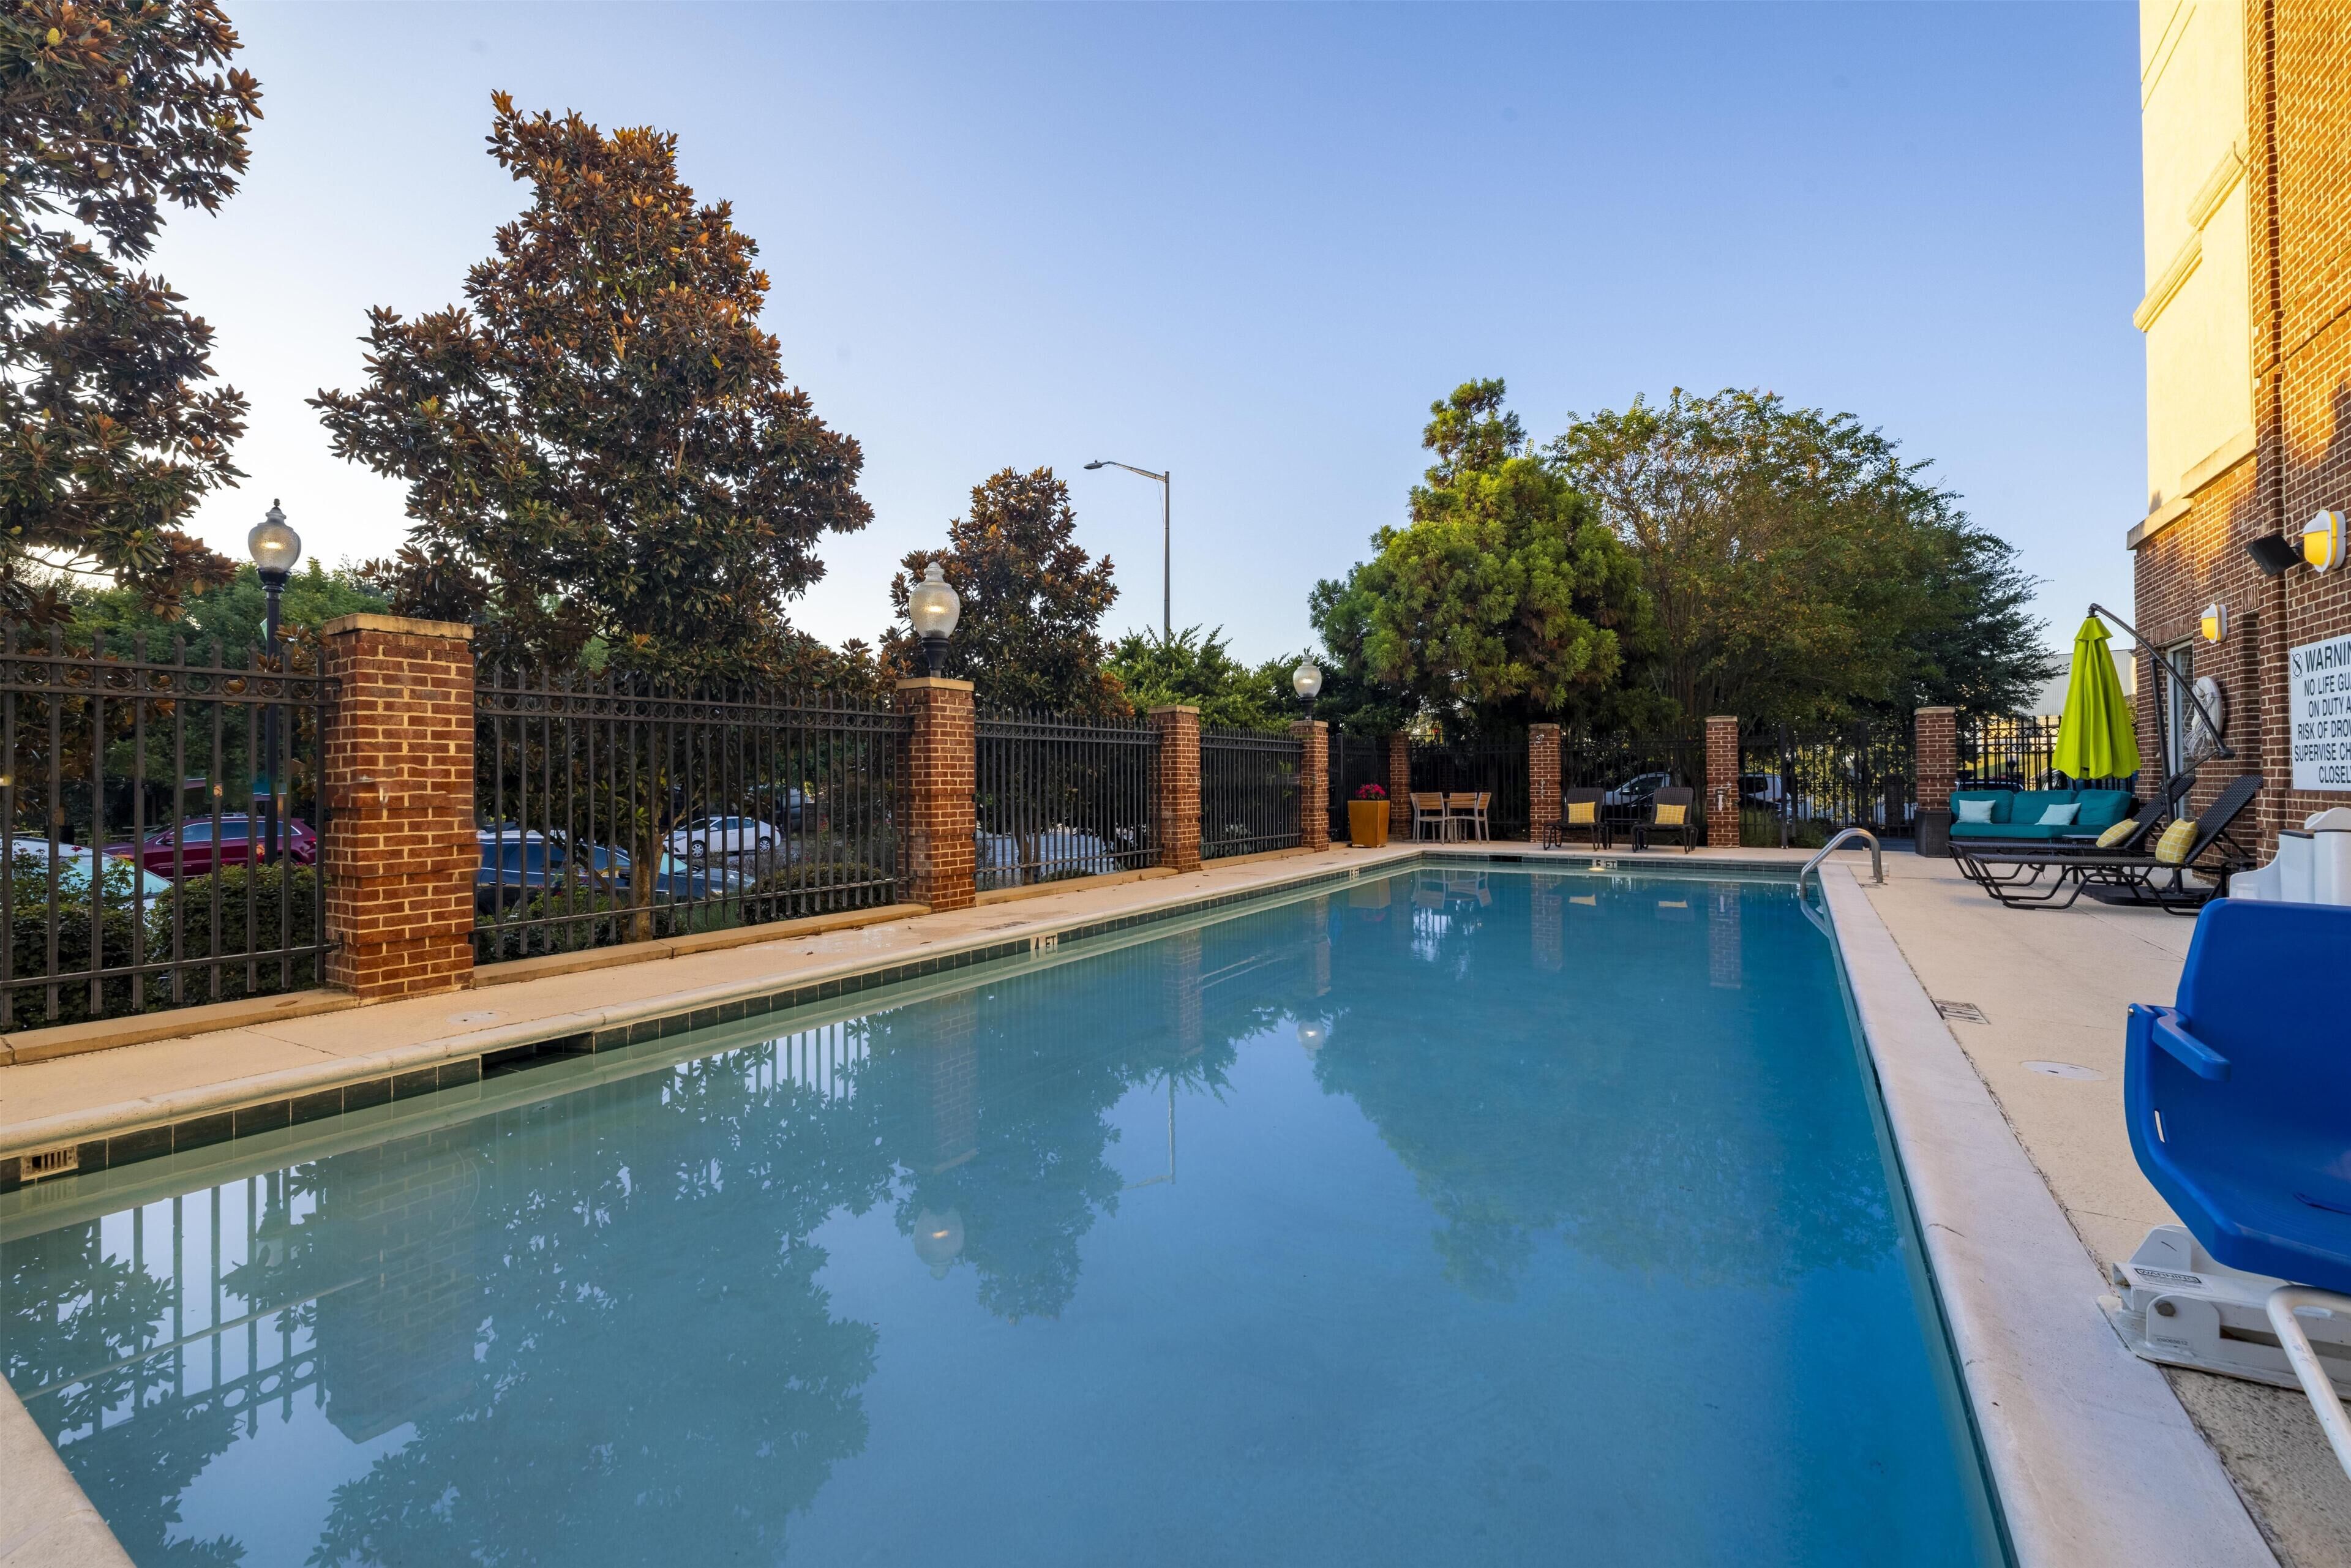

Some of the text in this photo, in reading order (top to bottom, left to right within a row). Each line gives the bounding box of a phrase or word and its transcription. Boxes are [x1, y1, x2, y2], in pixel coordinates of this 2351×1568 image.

[2304, 672, 2351, 697] NO LIFE GU
[2308, 700, 2319, 718] ON
[2322, 696, 2344, 716] DUTY
[2298, 722, 2315, 740] RISK
[2317, 721, 2328, 739] OF
[2294, 743, 2337, 762] SUPERVISE
[2319, 765, 2351, 784] CLOSEL
[2139, 1270, 2197, 1281] WARNING
